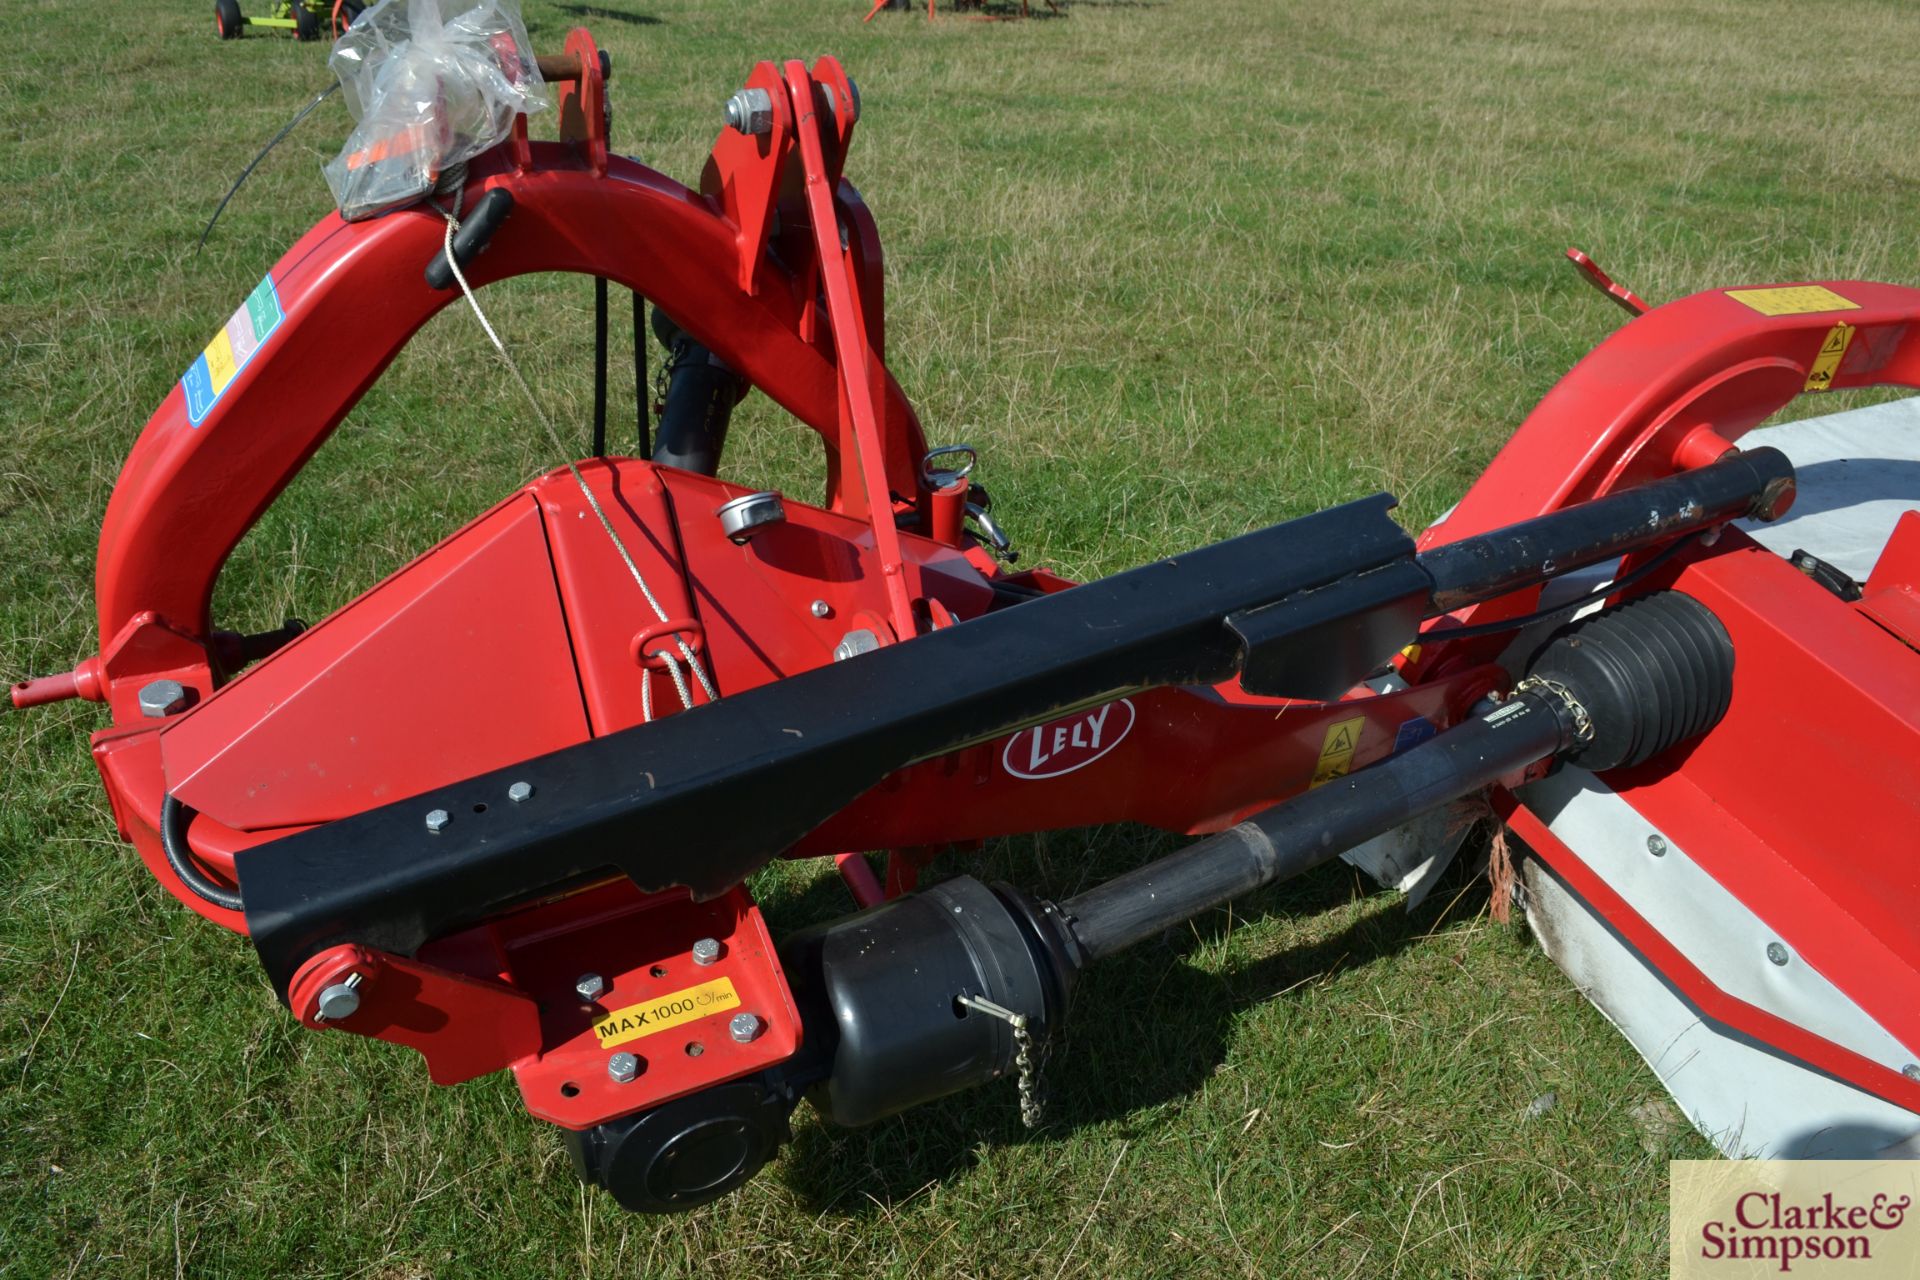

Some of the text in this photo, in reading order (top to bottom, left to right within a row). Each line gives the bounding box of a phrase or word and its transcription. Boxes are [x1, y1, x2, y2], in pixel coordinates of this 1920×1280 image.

[1029, 703, 1111, 772] LELY
[599, 1012, 650, 1038] MAX
[650, 998, 694, 1021] 1000
